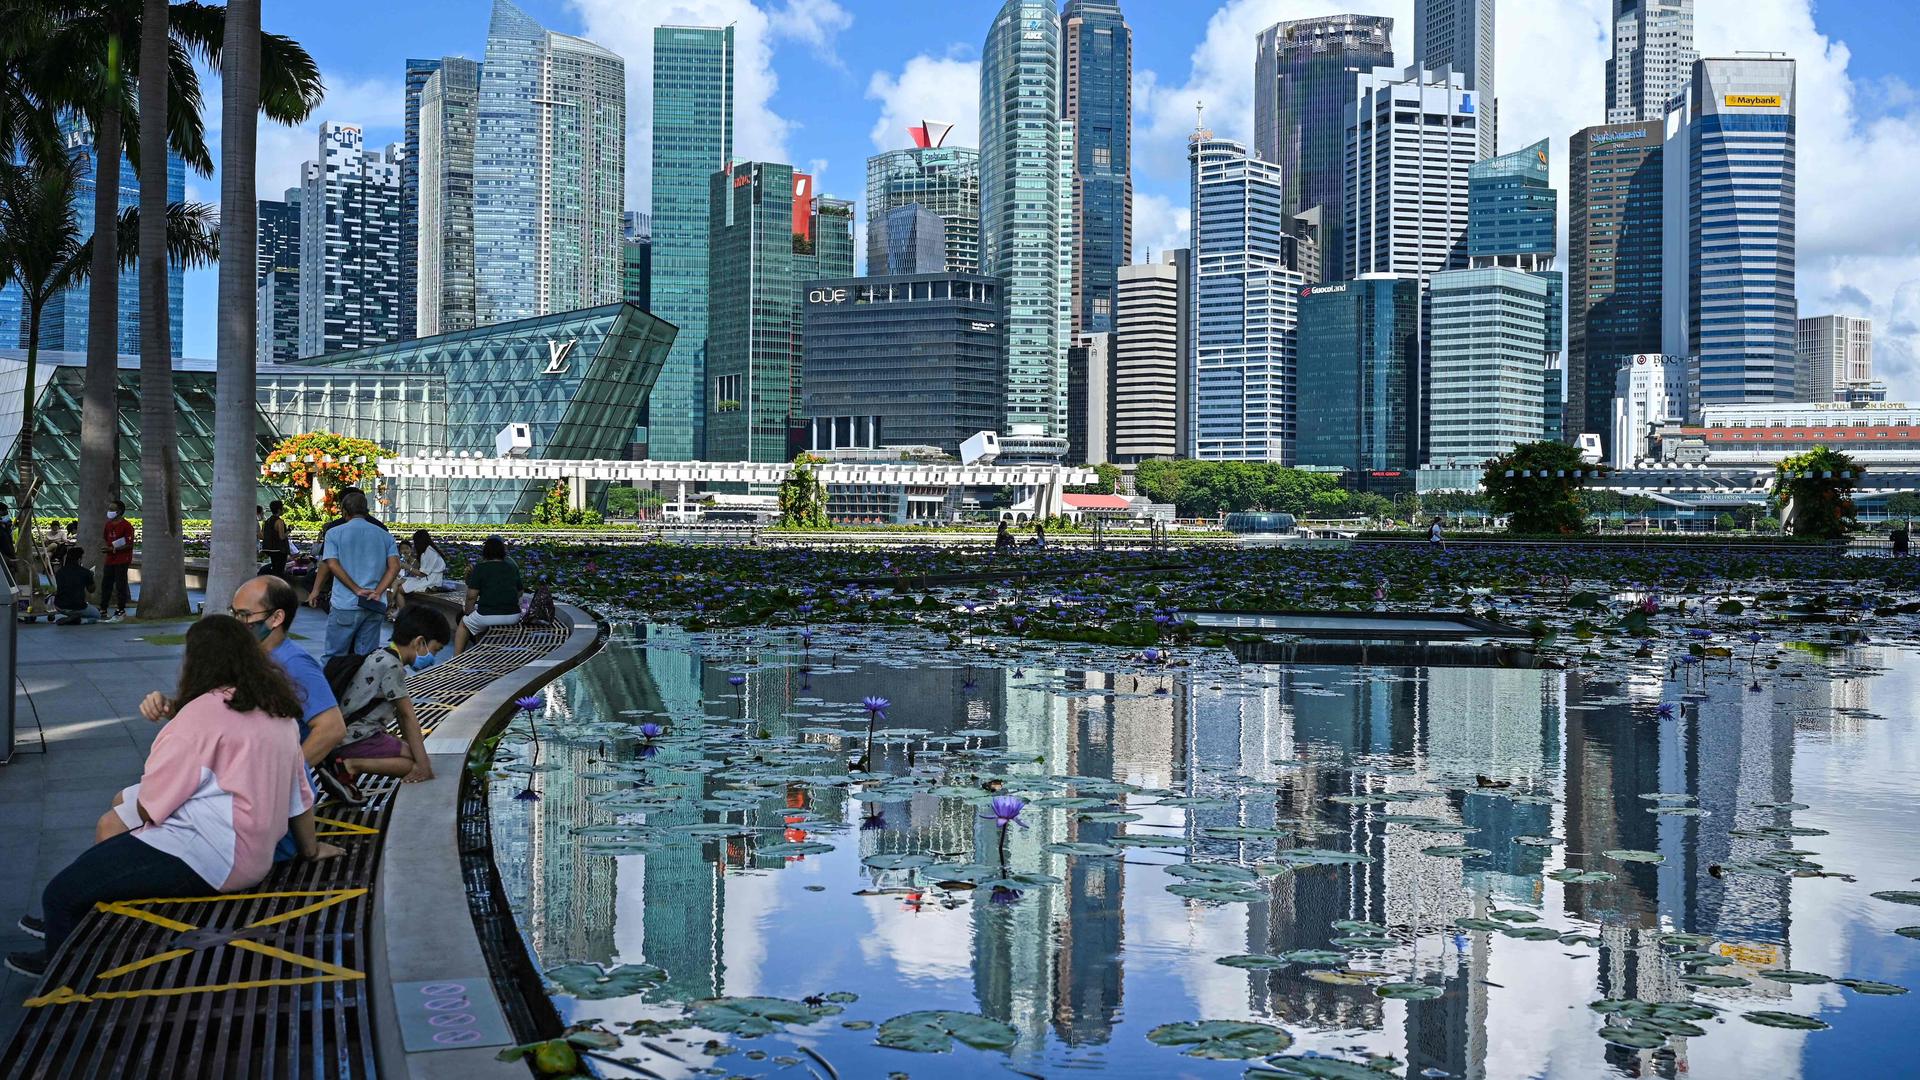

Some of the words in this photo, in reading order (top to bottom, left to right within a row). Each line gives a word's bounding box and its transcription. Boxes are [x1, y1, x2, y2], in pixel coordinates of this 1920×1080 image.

[1737, 97, 1776, 105] Maybank
[333, 130, 357, 145] citi
[1311, 284, 1346, 294] GuocoLand
[810, 290, 845, 302] OUE
[1654, 355, 1677, 365] BOC
